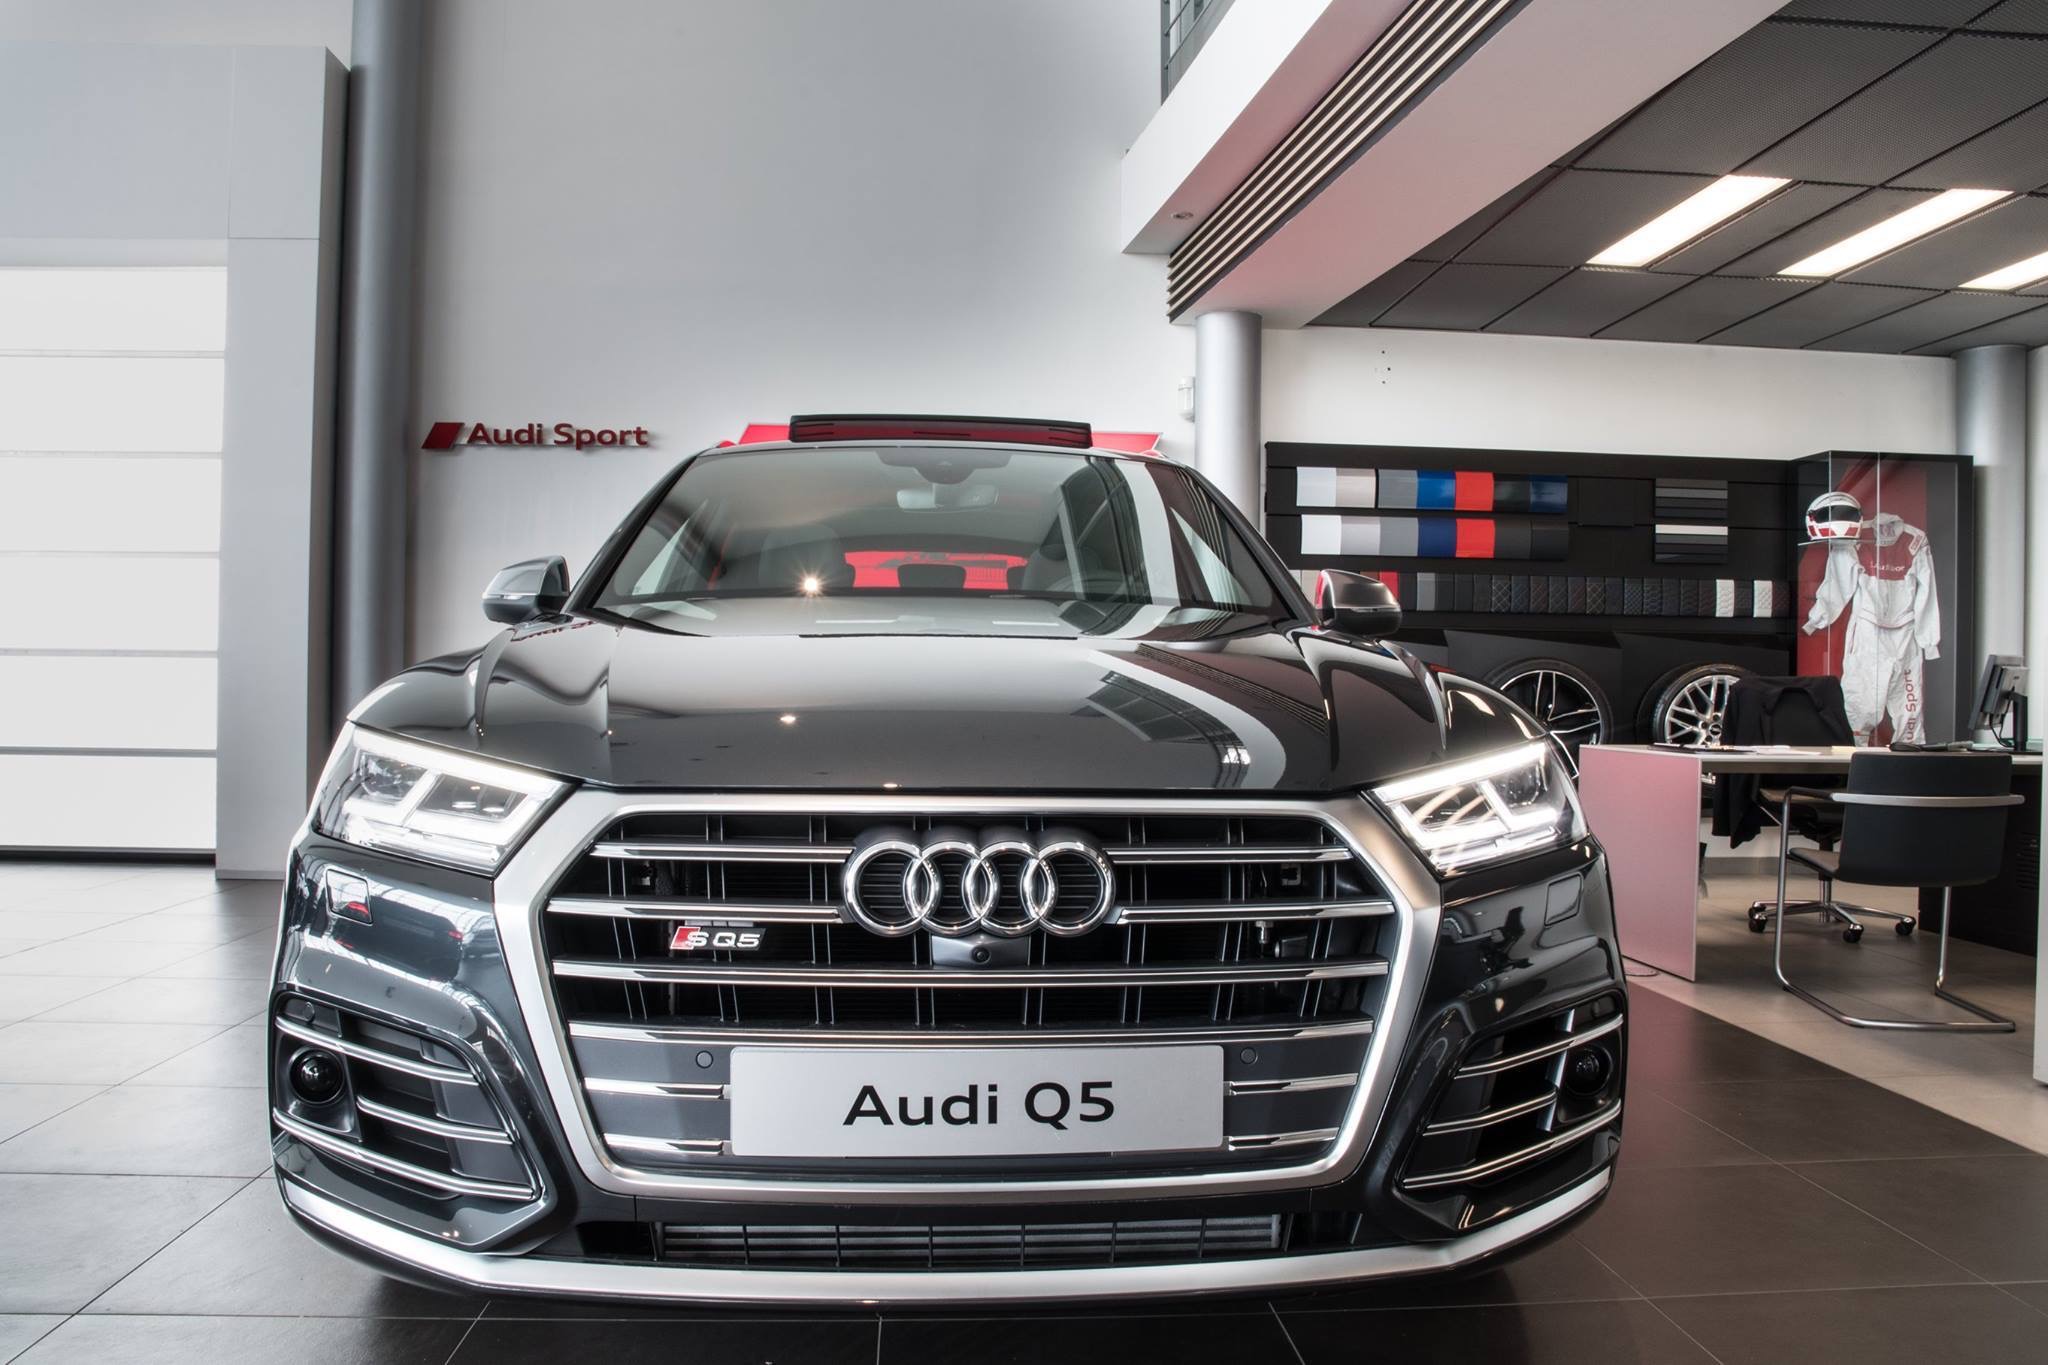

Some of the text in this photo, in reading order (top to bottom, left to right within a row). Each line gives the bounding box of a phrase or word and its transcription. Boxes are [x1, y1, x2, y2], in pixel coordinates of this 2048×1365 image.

[467, 422, 649, 451] Audi Sport
[1904, 668, 1918, 744] udi Sport
[842, 1081, 1115, 1130] Audi Q5
